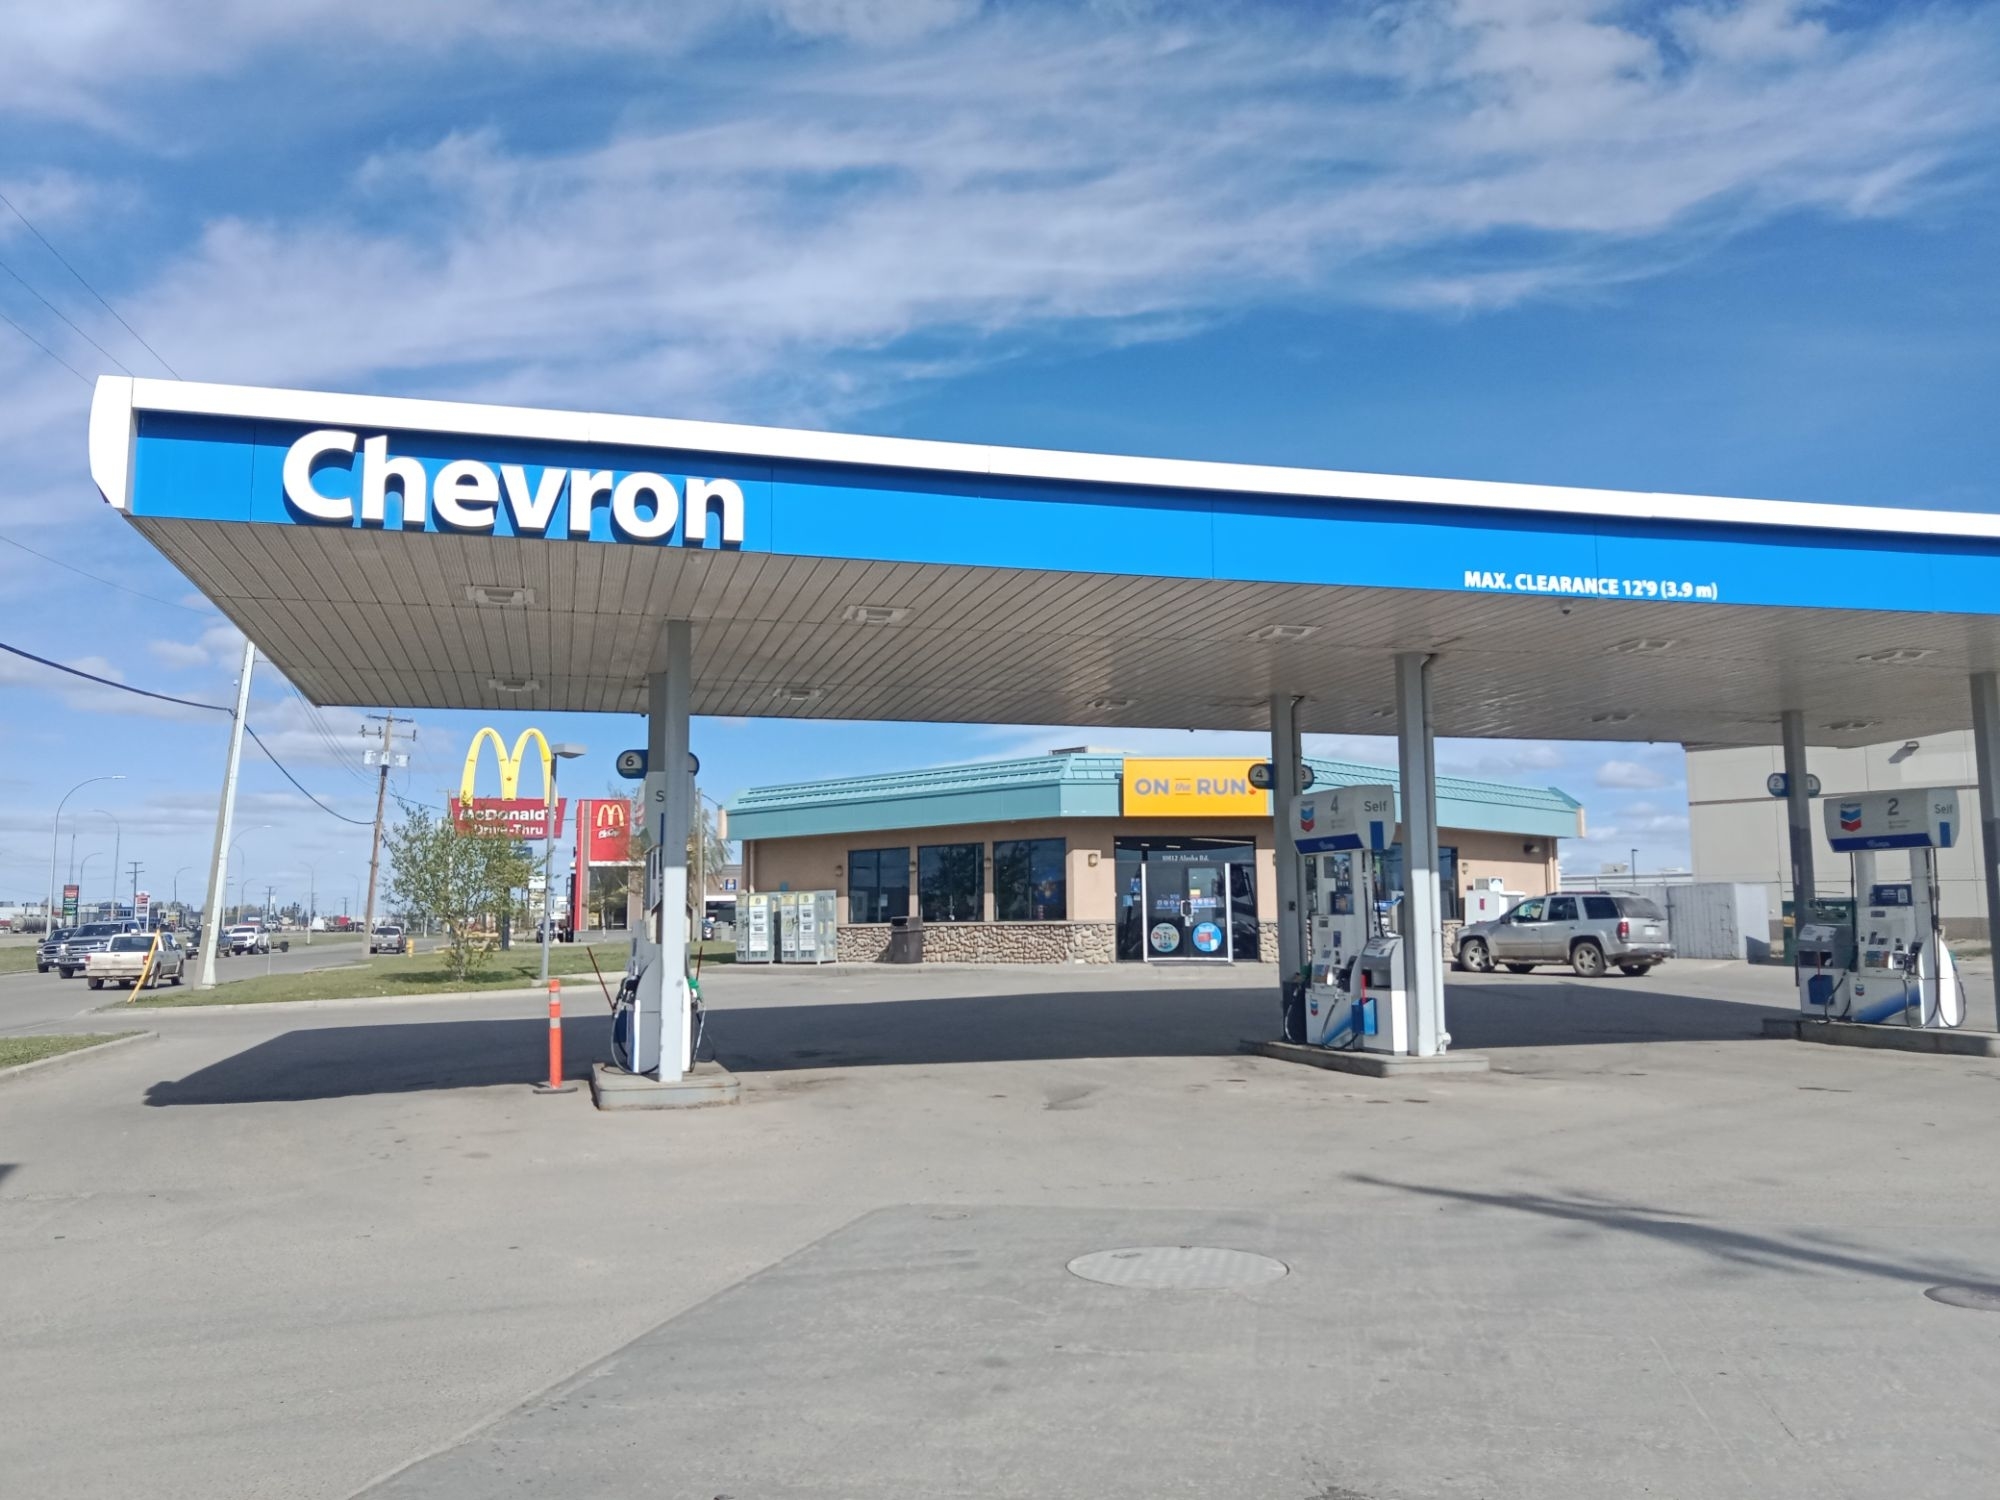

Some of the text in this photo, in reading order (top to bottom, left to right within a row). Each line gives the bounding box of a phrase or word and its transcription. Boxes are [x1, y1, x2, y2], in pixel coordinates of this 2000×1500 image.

[282, 429, 745, 544] Chevron
[1464, 571, 1512, 590] MAX.
[1515, 574, 1619, 595] CLEARANCE
[1661, 581, 1693, 599] (3.9
[1696, 582, 1718, 601] m)
[625, 755, 635, 767] 6
[1256, 769, 1263, 778] 4
[1135, 778, 1170, 795] ON
[1197, 778, 1247, 795] RUN
[1330, 795, 1339, 814] 4
[1364, 800, 1388, 812] Self
[1888, 798, 1899, 815] 2
[1934, 803, 1953, 815] Self
